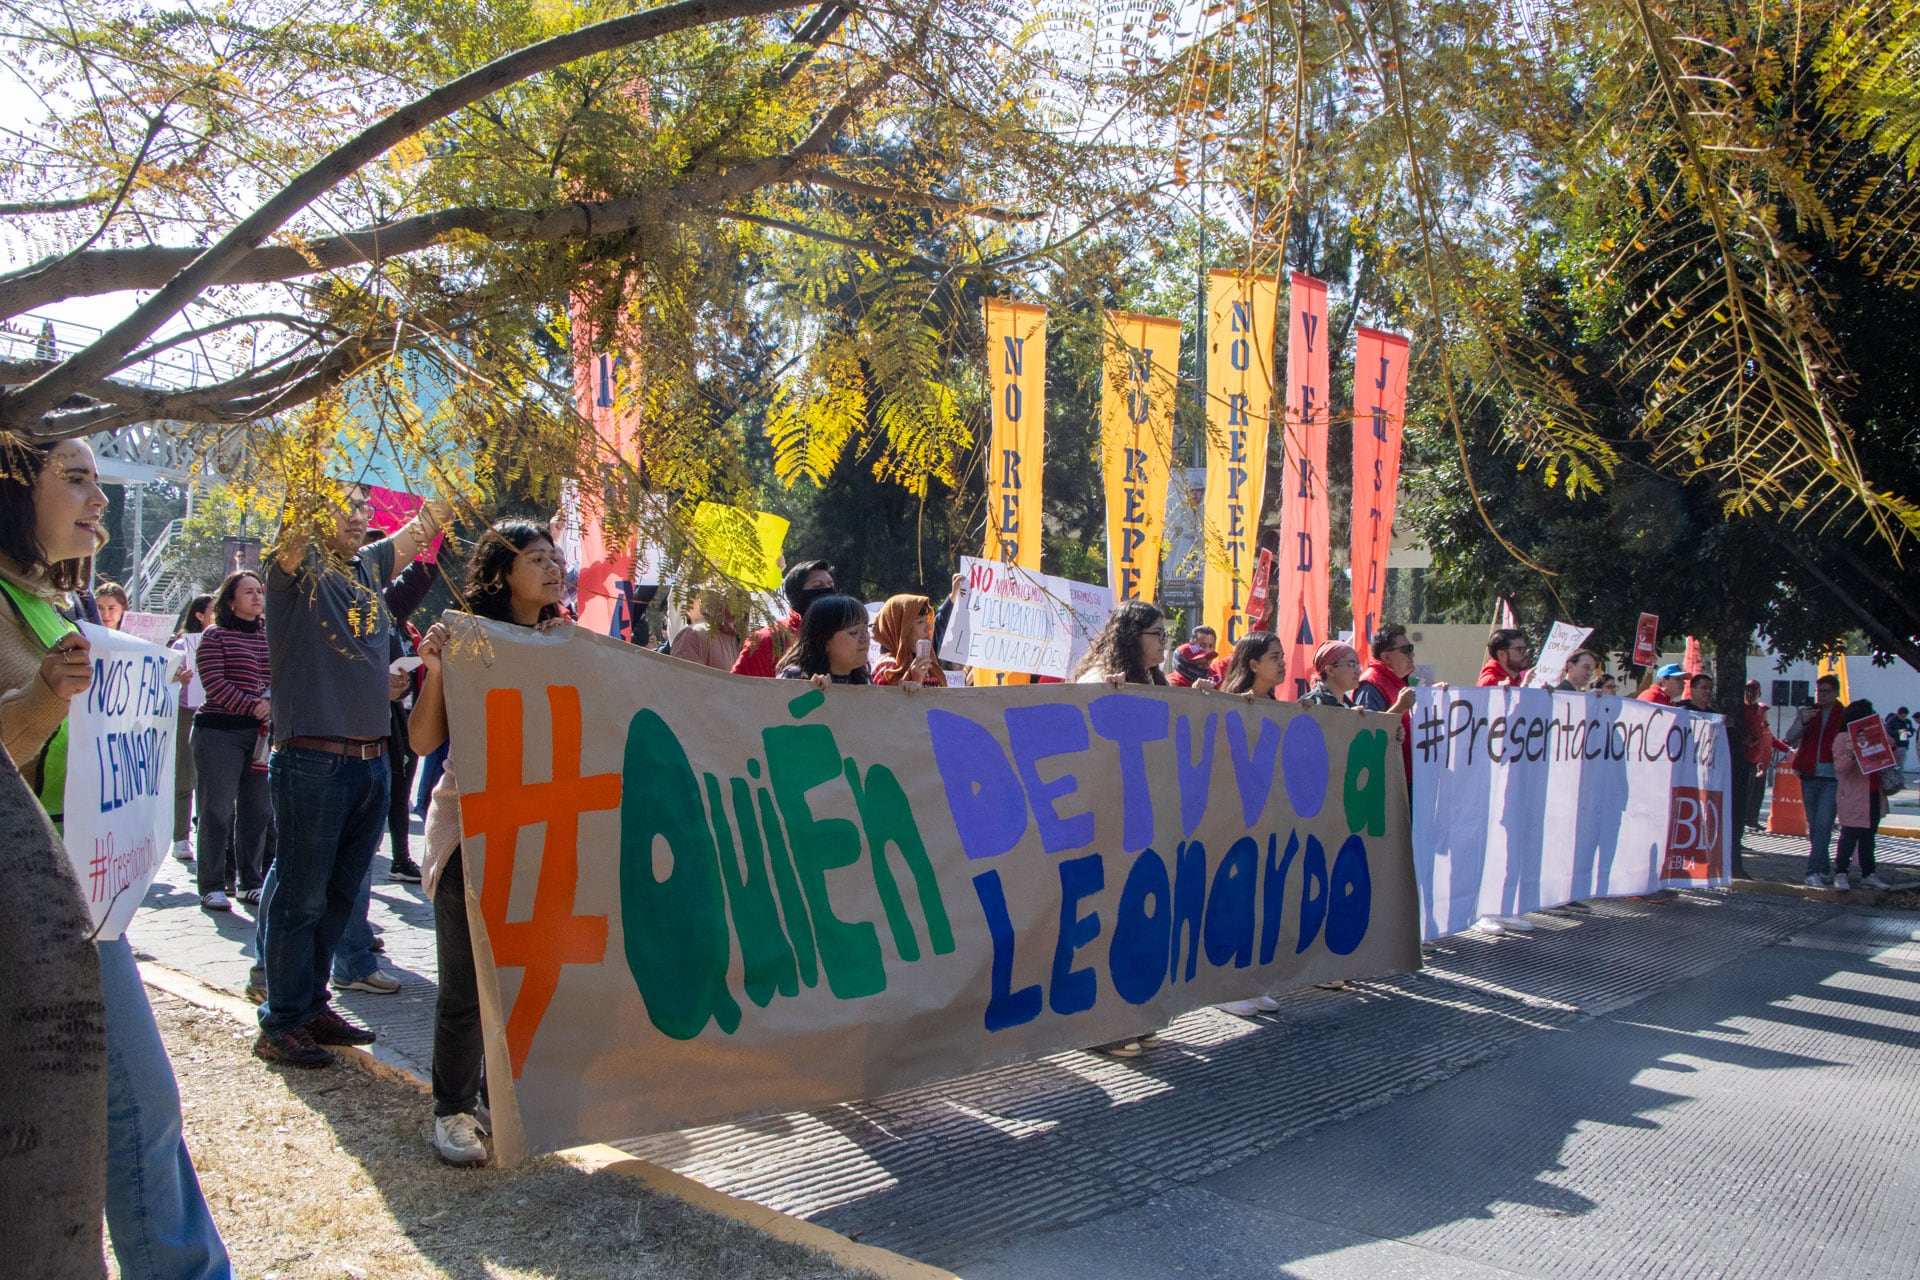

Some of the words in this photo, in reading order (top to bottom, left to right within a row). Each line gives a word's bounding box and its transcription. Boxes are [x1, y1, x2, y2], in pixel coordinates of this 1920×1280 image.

[1231, 300, 1250, 371] NO
[1004, 336, 1024, 422] NO
[970, 565, 993, 593] NO
[954, 630, 1052, 668] LEONARDO
[88, 659, 132, 717] NOS
[96, 728, 167, 814] LEONARDO
